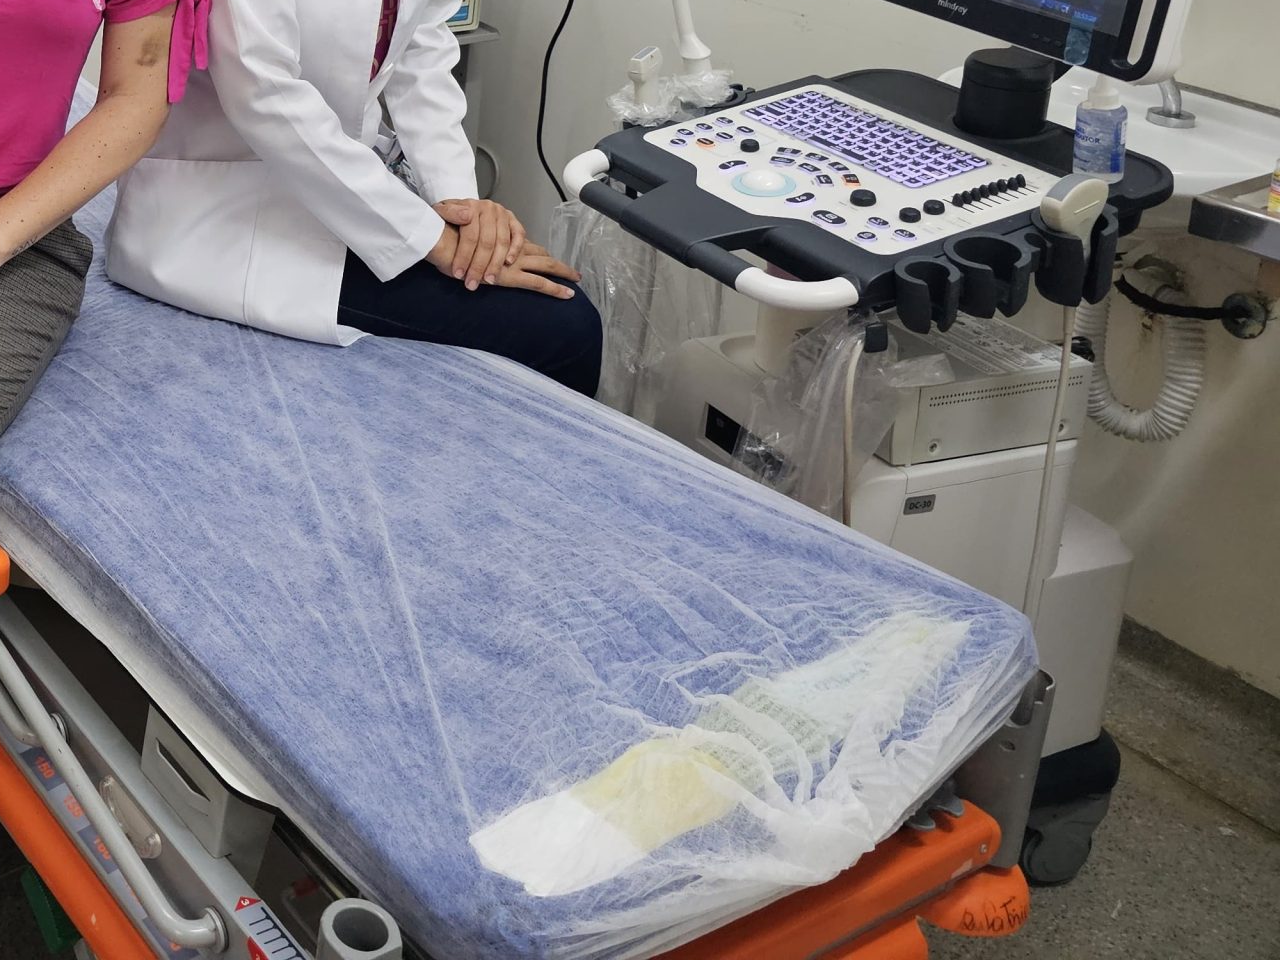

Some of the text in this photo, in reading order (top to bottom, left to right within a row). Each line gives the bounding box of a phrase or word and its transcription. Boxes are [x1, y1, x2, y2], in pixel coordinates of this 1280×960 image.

[937, 0, 968, 16] mindray
[909, 500, 932, 510] DC-30
[35, 755, 55, 779] 150
[241, 898, 250, 906] 3
